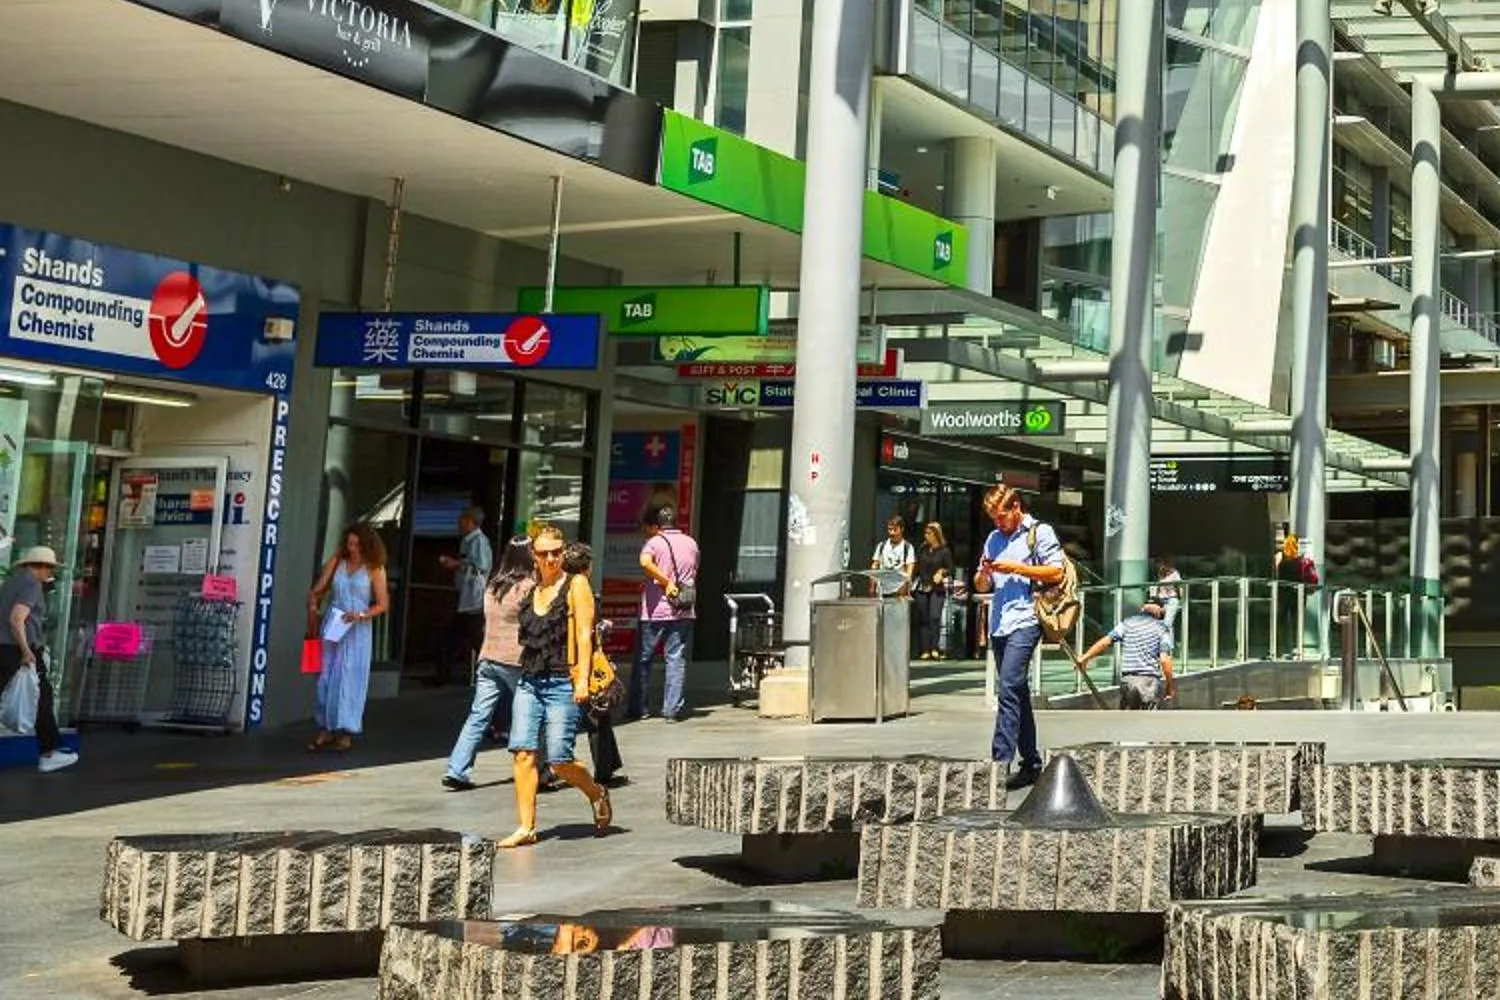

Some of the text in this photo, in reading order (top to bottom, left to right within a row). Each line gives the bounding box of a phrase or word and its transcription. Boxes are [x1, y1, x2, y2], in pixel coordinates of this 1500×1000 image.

[691, 148, 715, 176] TAB
[935, 239, 952, 262] TAB
[22, 246, 104, 288] Shands
[20, 283, 145, 329] Compounding
[624, 303, 653, 318] TAB
[17, 310, 95, 343] Chemist
[414, 319, 470, 333] Shands
[363, 318, 402, 363] 藥
[413, 334, 501, 348] Compounding
[411, 347, 465, 360] Chemist
[265, 371, 288, 390] 428
[729, 365, 757, 375] POST
[707, 382, 757, 405] SMC
[877, 385, 918, 397] Clinic
[931, 409, 1022, 429] Woolworths
[249, 400, 289, 722] PRESCRIPTIONS
